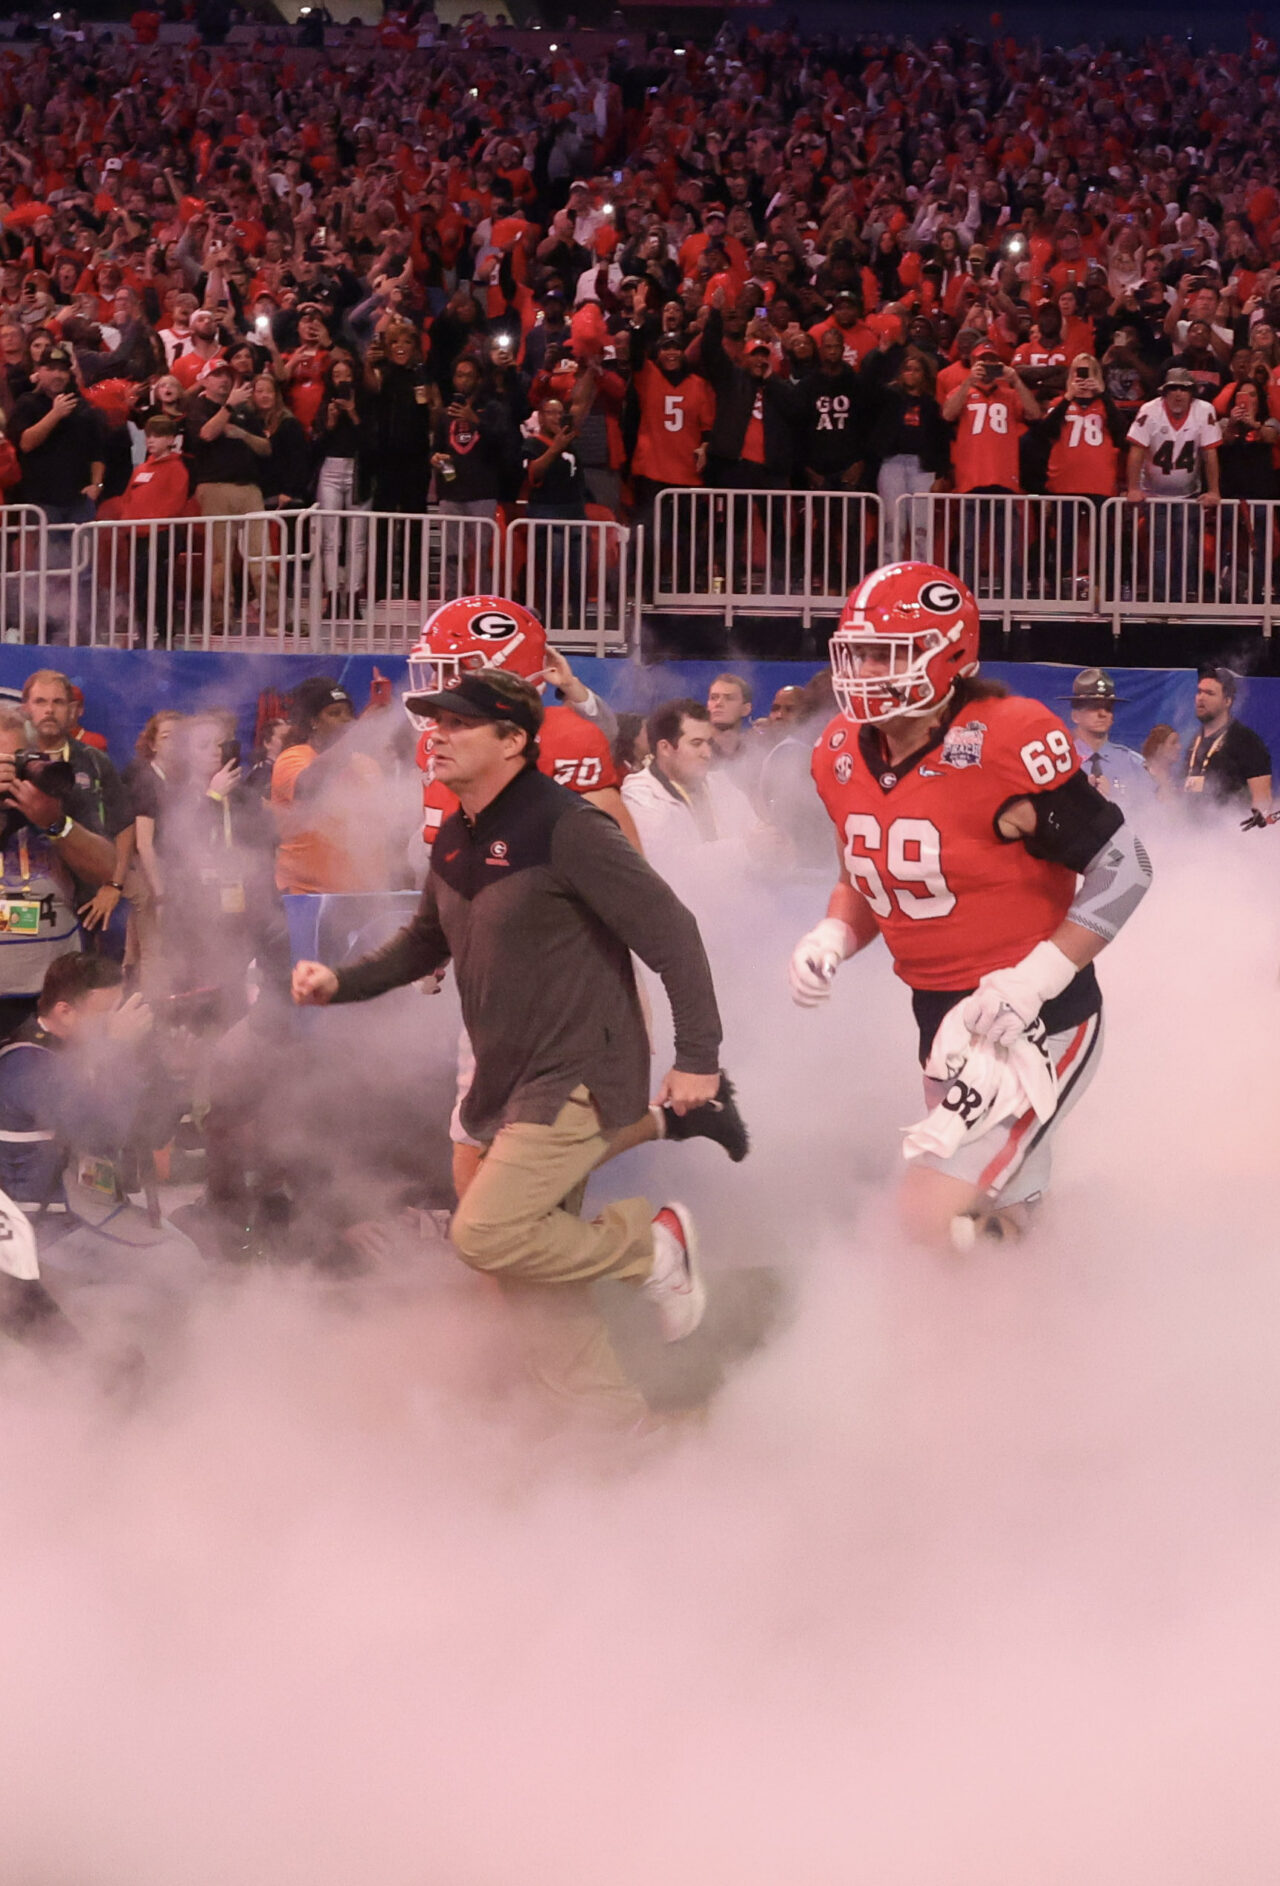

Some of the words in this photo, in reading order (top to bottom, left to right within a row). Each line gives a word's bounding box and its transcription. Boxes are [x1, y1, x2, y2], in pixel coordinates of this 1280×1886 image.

[664, 396, 684, 431] 5
[816, 395, 850, 413] GO
[967, 403, 1008, 435] 78
[816, 413, 849, 430] AT
[1064, 414, 1104, 447] 78
[1153, 440, 1194, 475] 44
[553, 756, 602, 786] 50
[1020, 730, 1072, 786] 69
[844, 813, 957, 920] 69
